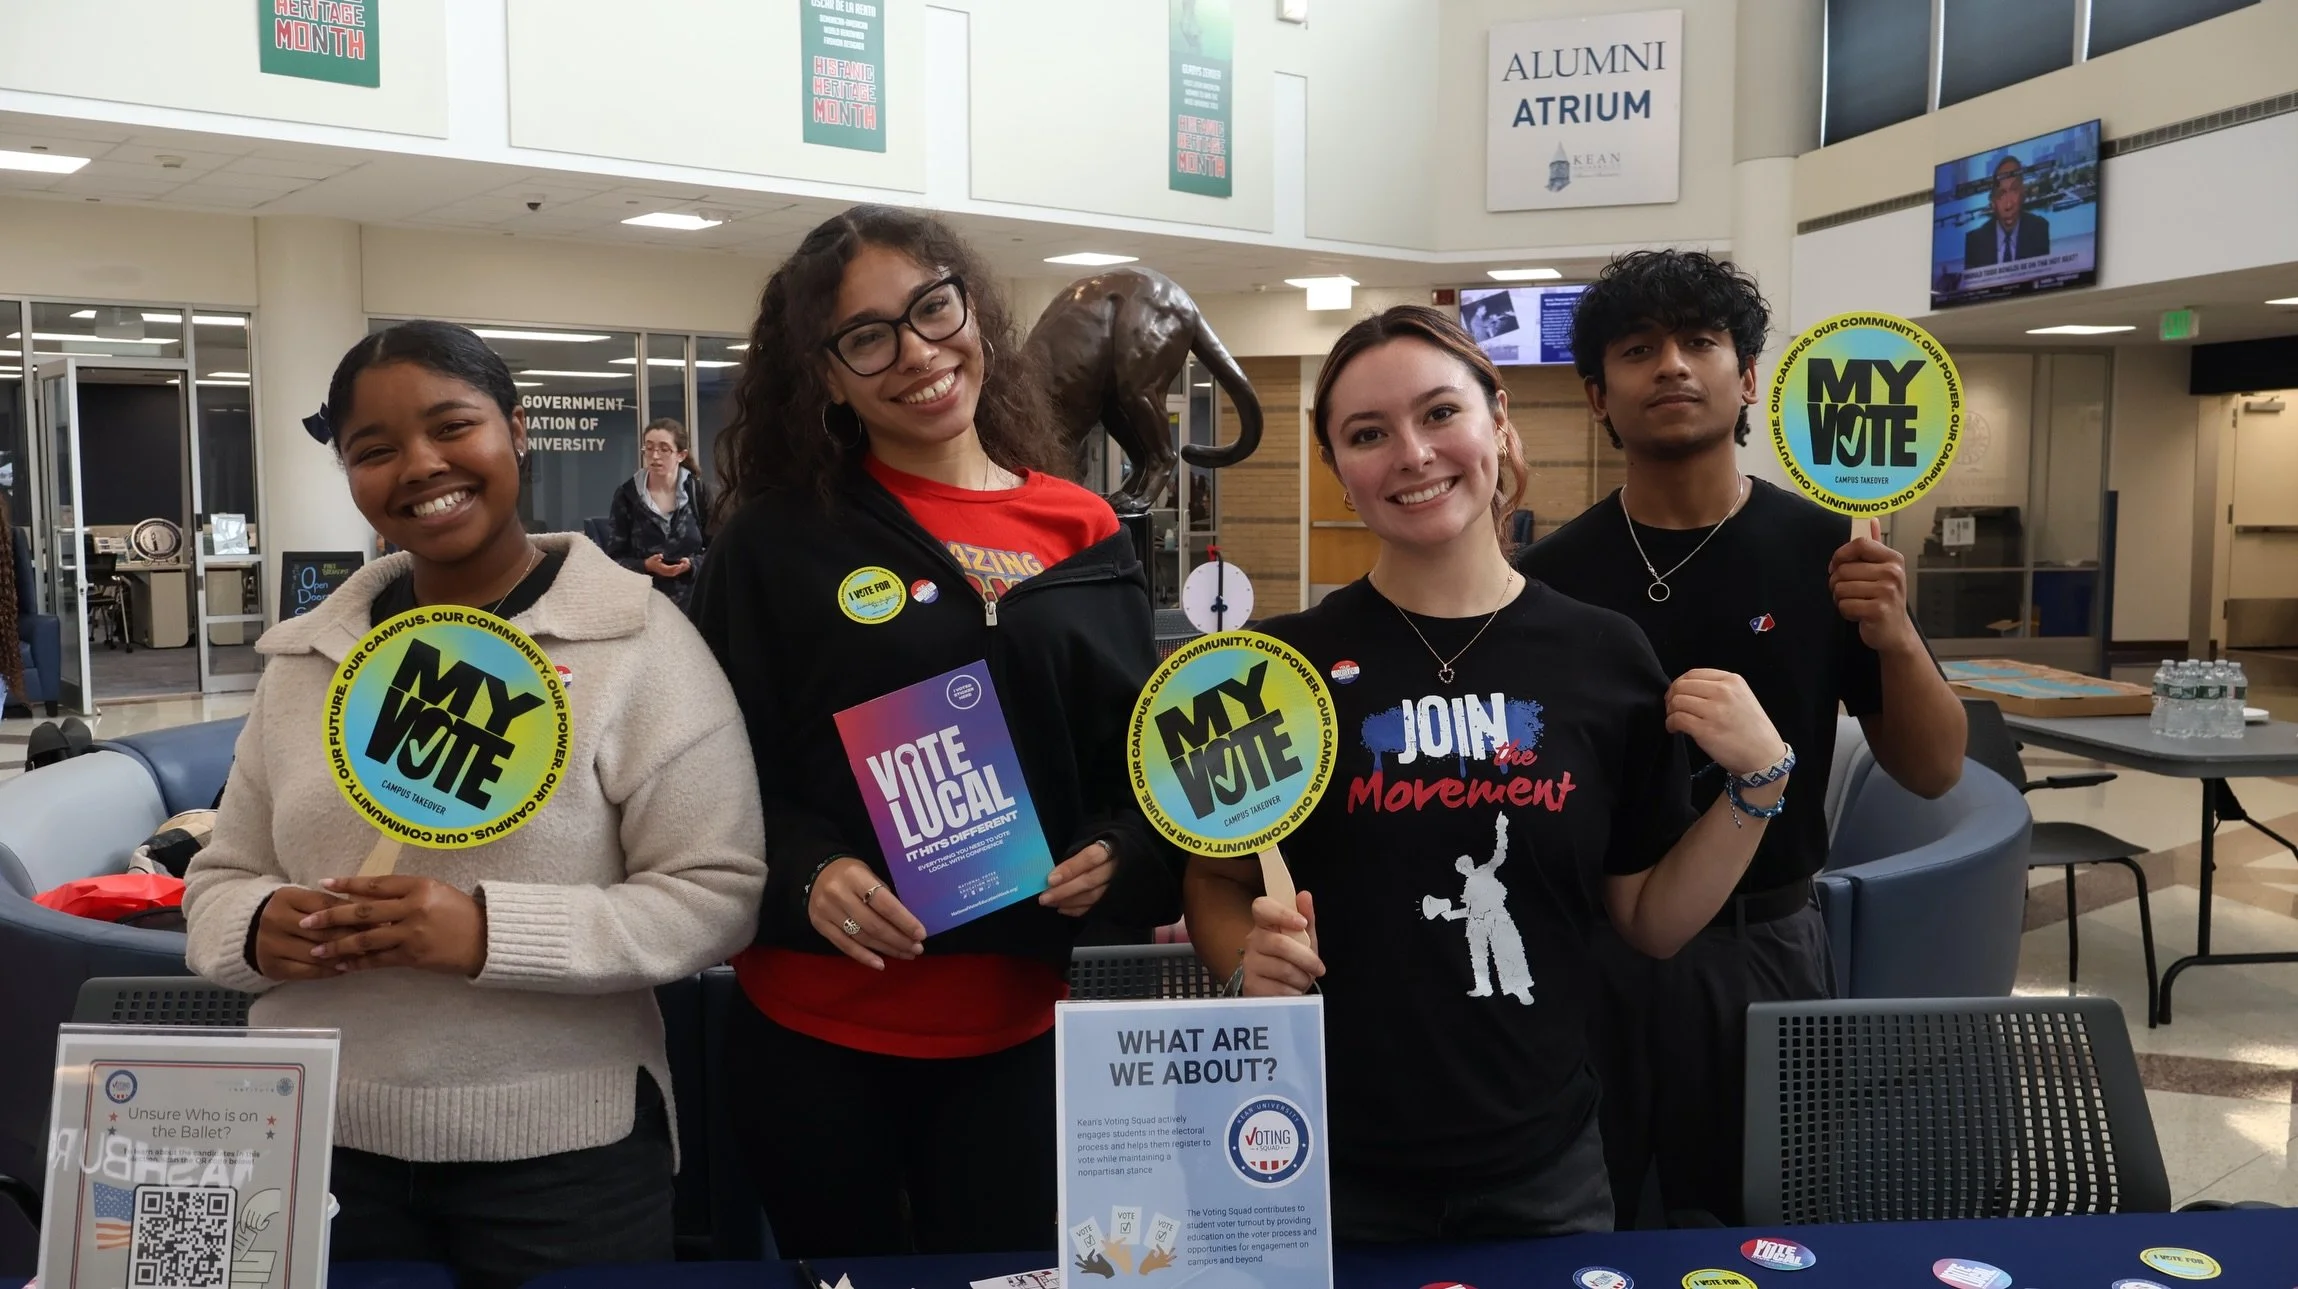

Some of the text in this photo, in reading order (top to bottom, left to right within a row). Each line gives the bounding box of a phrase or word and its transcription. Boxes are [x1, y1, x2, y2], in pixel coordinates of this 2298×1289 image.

[275, 0, 365, 27] HERITAGE
[811, 0, 834, 10] OSCAR
[836, 0, 845, 12] DE
[846, 2, 854, 14] LA
[276, 18, 365, 60] MONTH
[814, 56, 875, 83] HISPANIC
[1502, 41, 1666, 81] ALUMNI
[813, 76, 876, 102] HERITAGE
[814, 97, 876, 130] MONTH
[1512, 90, 1651, 127] ATRIUM
[1177, 150, 1225, 178] MONTH
[1574, 153, 1621, 165] KEAN
[1808, 358, 1927, 404] MY
[522, 395, 624, 410] GOVERNMENT
[1772, 317, 1960, 512] OUR CAMPUS. OUR COMMUNITY. OUR POWER. OUR CAMPUS. OUR COMMUNITY. OUR FUTURE.
[526, 417, 599, 431] IATION OF
[1807, 403, 1918, 467] VOTE
[528, 437, 606, 451] NIVERSITY
[1835, 476, 1889, 485] CAMPUS TAKEOVER
[947, 541, 1045, 576] AZING
[302, 567, 328, 593] Open
[848, 580, 891, 601] I VOTE FOR
[432, 612, 464, 622] OUR
[364, 614, 430, 653] CAMPUS.
[467, 615, 551, 679] COMMUNITY.
[343, 652, 367, 679] OUR
[391, 638, 546, 737] MY
[547, 679, 566, 710] OUR
[329, 684, 348, 747] FUTURE.
[1155, 660, 1268, 760] MY
[550, 711, 568, 770] POWER.
[1398, 693, 1538, 766] JOIN the
[365, 685, 515, 811] VOTE
[1132, 637, 1332, 853] OUR CAMPUS. OUR COMMUNITY. OUR POWER. OUR CAMPUS. OUR COMMUNITY. OUR FUTURE.
[332, 750, 350, 779] OUR
[866, 725, 972, 801] VOTE
[1171, 709, 1303, 820] VOTE
[381, 780, 446, 815] CAMPUS TAKEOVER
[536, 772, 557, 801] OUR
[1348, 771, 1576, 814] Movement
[345, 779, 433, 842] COMMUNITY.
[471, 801, 536, 839] CAMPUS.
[889, 764, 1015, 849] LOCAL
[1224, 795, 1281, 827] CAMPUS TAKEOVER
[436, 833, 468, 843] OUR
[905, 811, 1018, 862] IT HITS DIFFERENT
[918, 853, 956, 871] EVERYTHING
[969, 841, 986, 852] NEED
[994, 830, 1010, 840] VOTE
[928, 840, 1003, 873] LOCAL WITH CONFIDENCE
[1117, 1027, 1268, 1054] WHAT ARE
[1110, 1057, 1277, 1086] WE ABOUT?
[128, 1107, 258, 1122] Unsure Who is on
[1104, 1117, 1129, 1126] Voting
[1132, 1116, 1155, 1126] Squad
[1158, 1115, 1186, 1124] actively
[1237, 1104, 1299, 1124] KEAN UNIVERSITY
[152, 1125, 231, 1139] the Ballet?
[1077, 1131, 1110, 1140] engages
[1113, 1129, 1146, 1137] students
[1172, 1126, 1205, 1135] electoral
[1078, 1144, 1108, 1152] process
[1110, 1142, 1125, 1150] and
[1128, 1141, 1148, 1151] helps
[1150, 1140, 1170, 1148] them
[1172, 1140, 1202, 1149] register
[1078, 1156, 1095, 1164] vote
[1119, 1154, 1165, 1162] maintaining
[1078, 1168, 1124, 1177] nonpartisan
[1118, 1212, 1135, 1220] VOTE
[1187, 1209, 1201, 1217] The
[1202, 1208, 1227, 1217] Voting
[1229, 1206, 1252, 1216] Squad
[1254, 1205, 1295, 1214] contributes
[1187, 1221, 1215, 1229] student
[1217, 1220, 1235, 1228] voter
[1266, 1218, 1275, 1226] by
[1277, 1216, 1311, 1225] providing
[1076, 1224, 1093, 1236] VOTE
[1158, 1220, 1174, 1232] VOTE
[1187, 1233, 1224, 1241] education
[1238, 1231, 1249, 1239] the
[1272, 1230, 1301, 1238] process
[1303, 1228, 1317, 1236] and
[1187, 1244, 1237, 1254] opportunities
[1239, 1243, 1249, 1251] for
[1251, 1242, 1297, 1251] engagement
[1188, 1255, 1263, 1266] campus and beyond
[1757, 1239, 1796, 1256] VOTE
